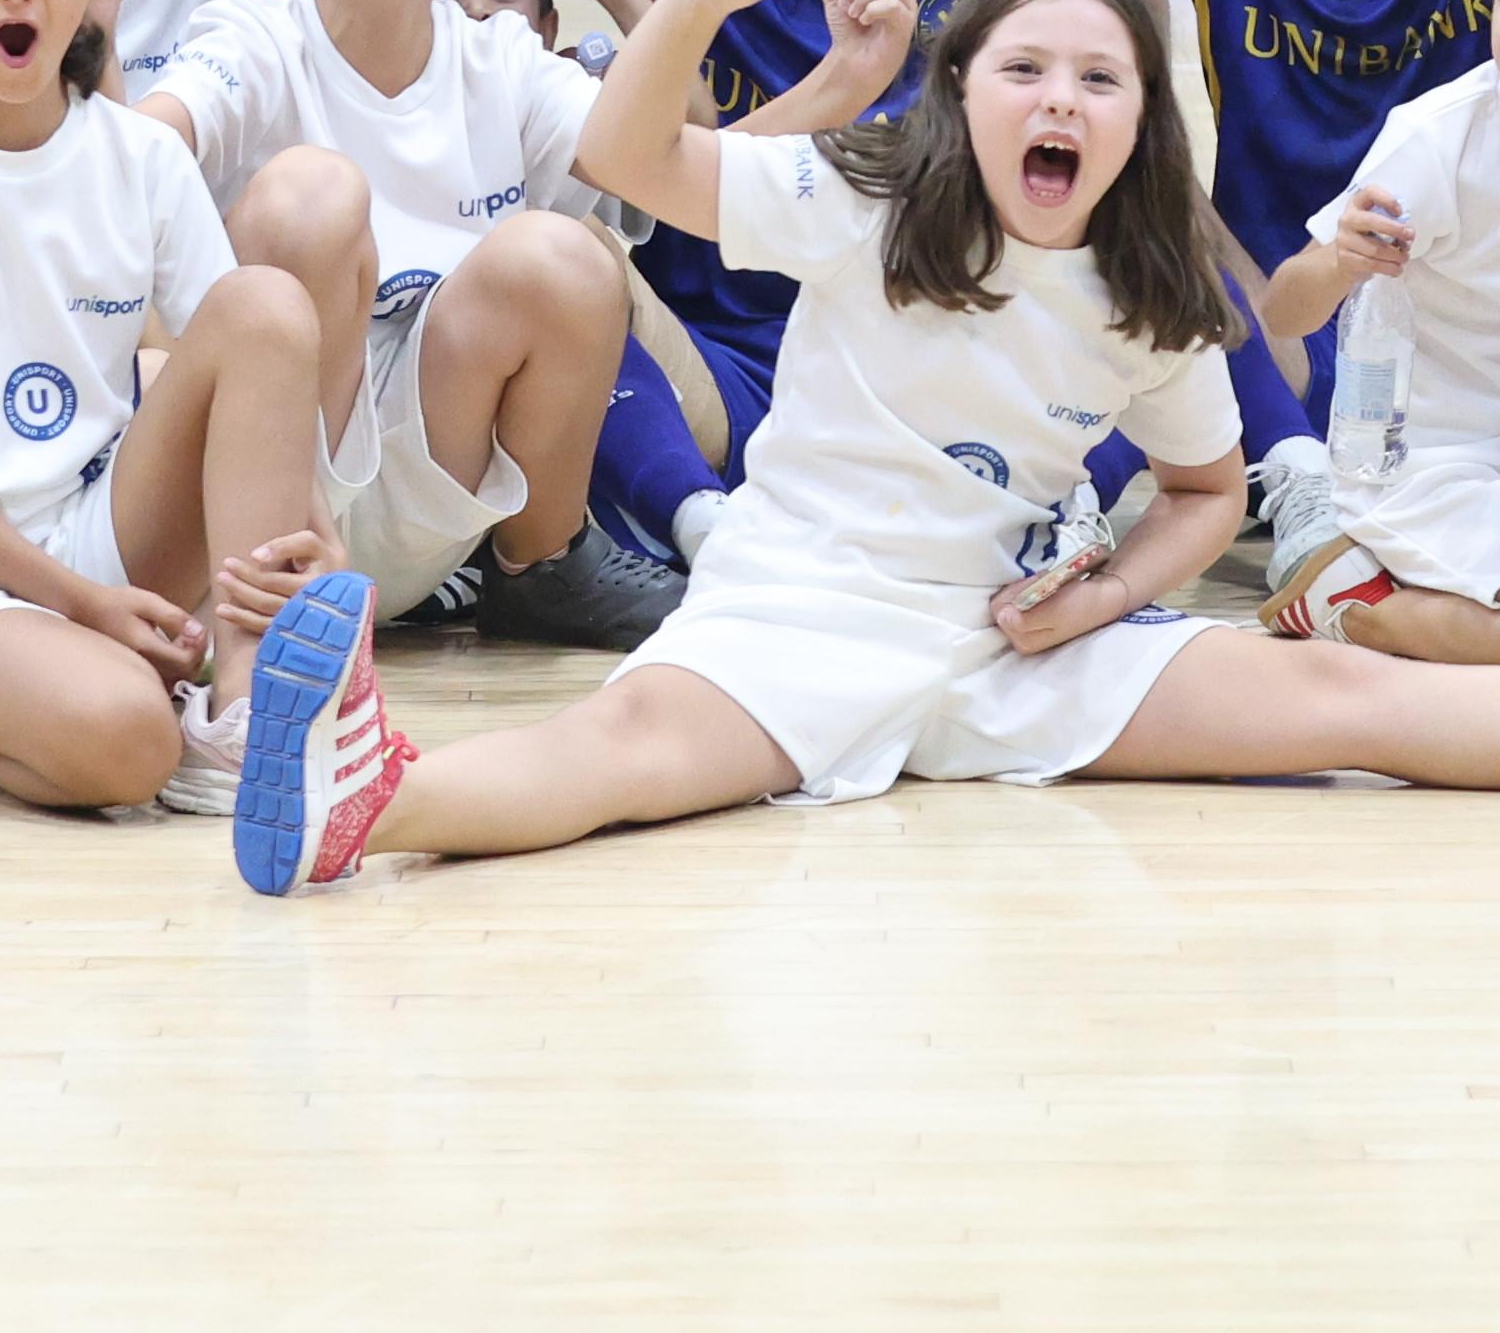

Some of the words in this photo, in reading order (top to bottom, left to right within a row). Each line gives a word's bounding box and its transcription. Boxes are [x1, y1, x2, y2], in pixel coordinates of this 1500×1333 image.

[381, 274, 433, 295] UNISPO
[66, 295, 145, 319] unisport
[27, 388, 48, 414] U
